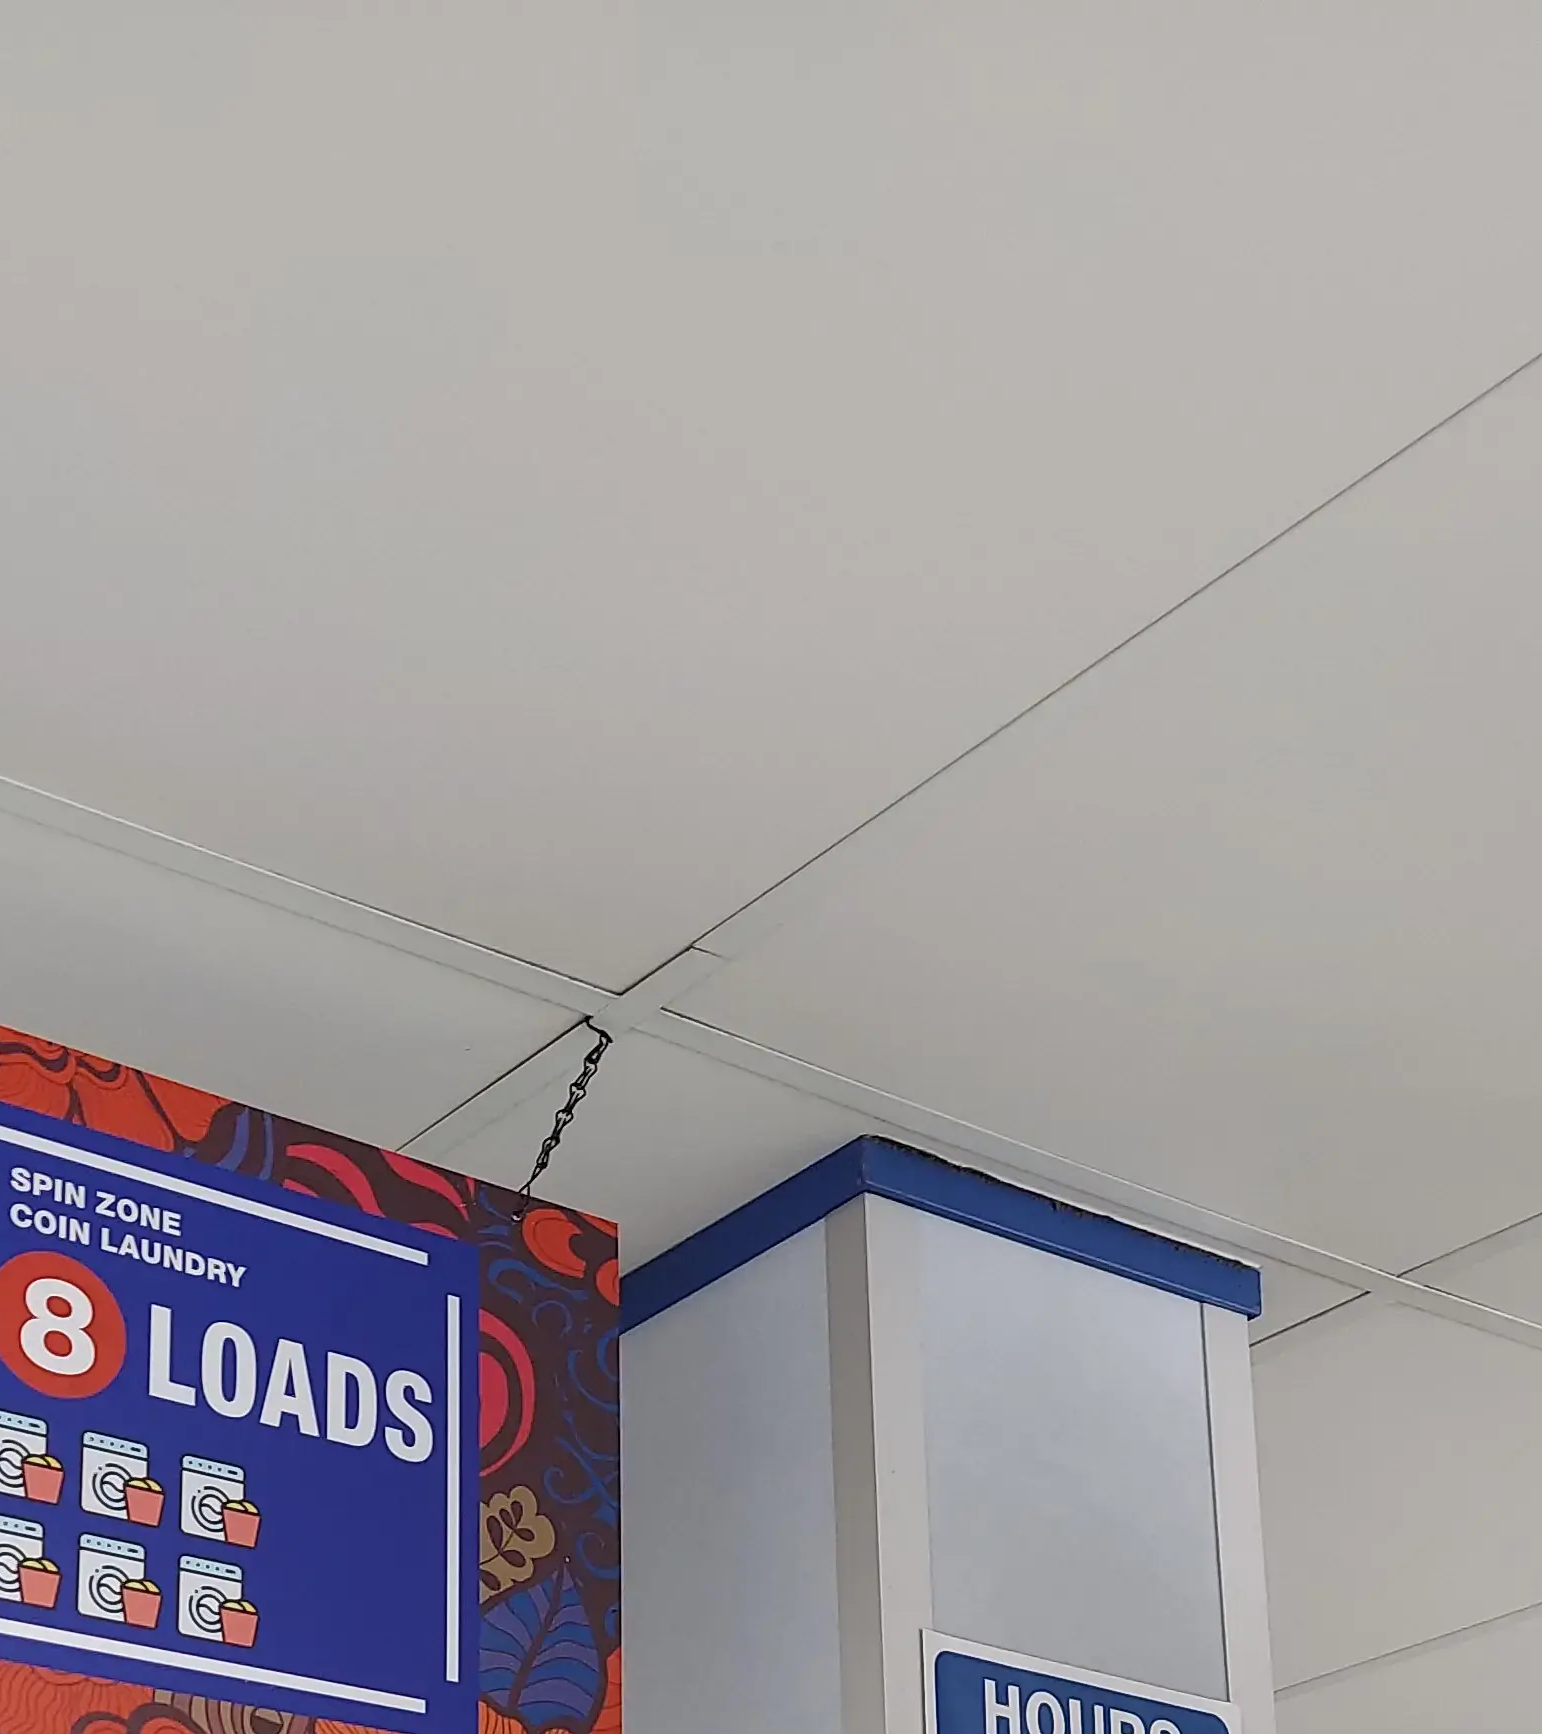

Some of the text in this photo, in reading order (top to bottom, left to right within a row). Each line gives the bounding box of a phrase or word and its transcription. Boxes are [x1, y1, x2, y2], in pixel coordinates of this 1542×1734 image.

[11, 1167, 182, 1236] SPIN ZONE
[10, 1204, 246, 1287] COIN LAUNDRY
[20, 1278, 95, 1375] 8
[149, 1304, 433, 1462] LOADS
